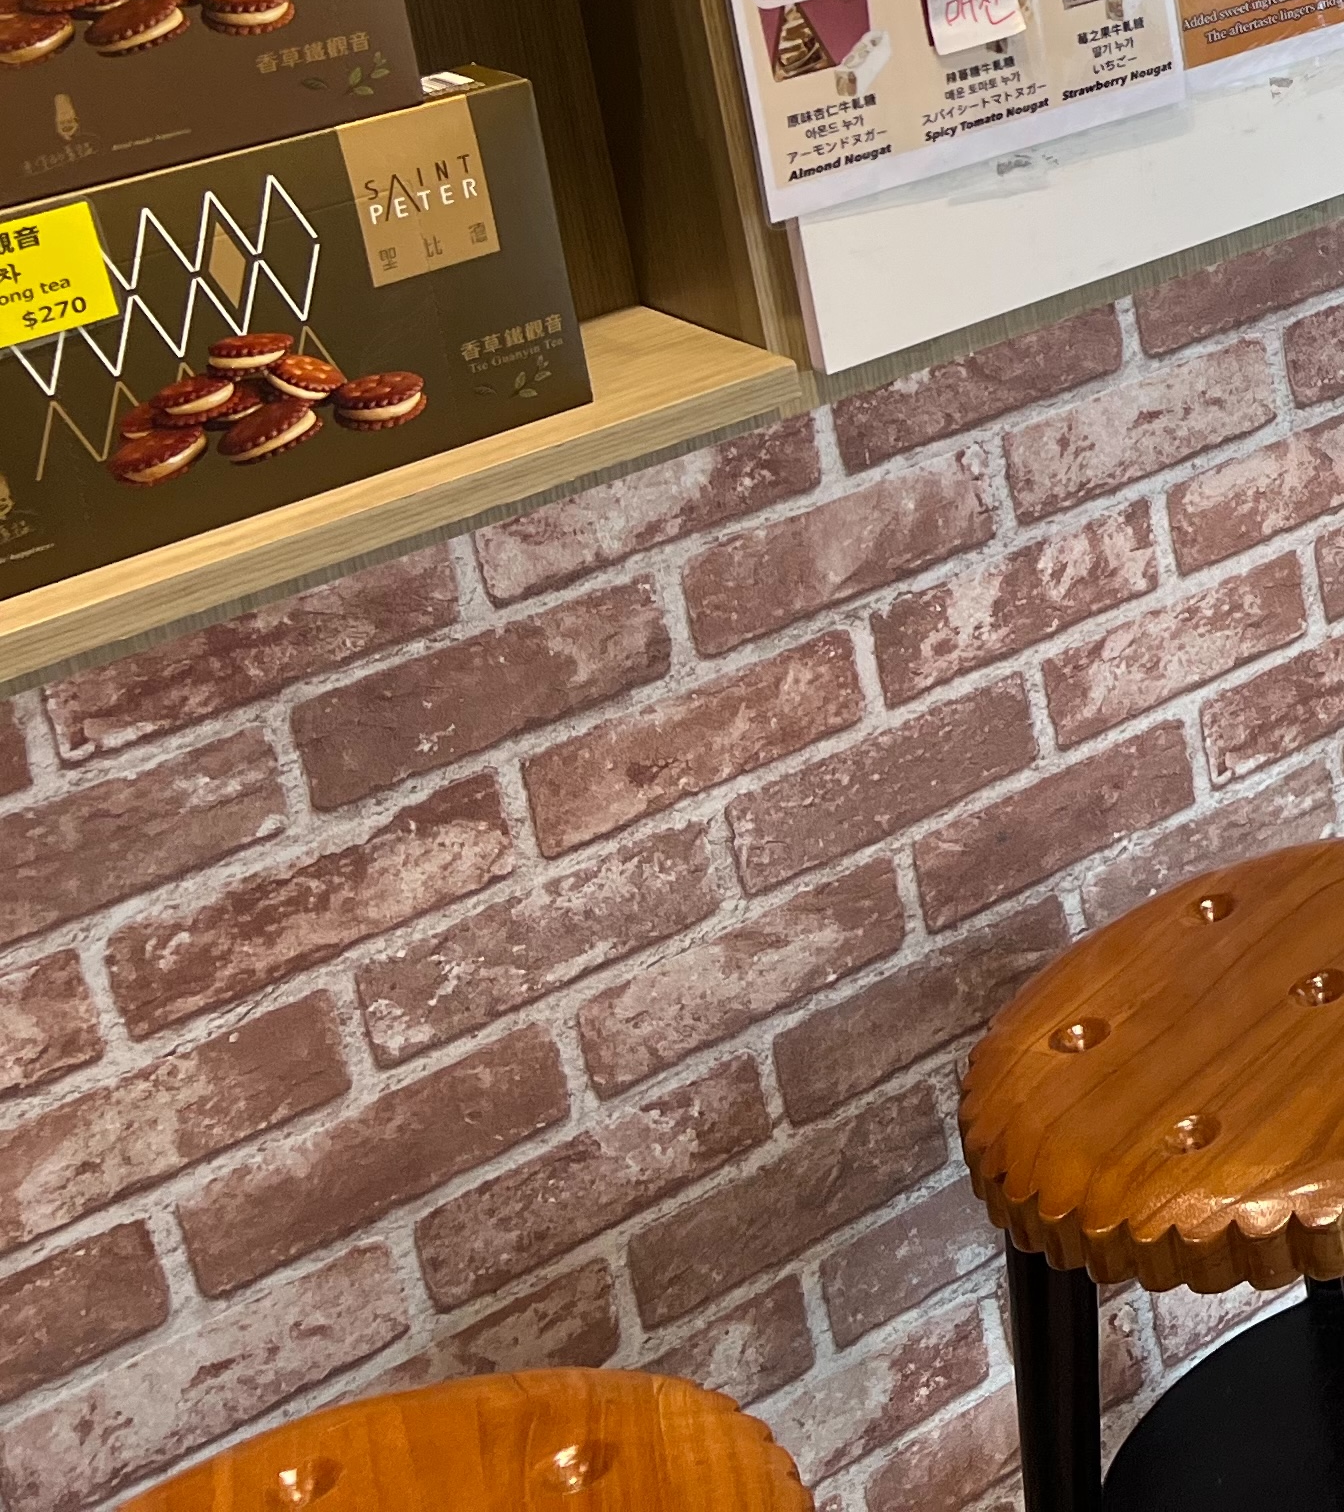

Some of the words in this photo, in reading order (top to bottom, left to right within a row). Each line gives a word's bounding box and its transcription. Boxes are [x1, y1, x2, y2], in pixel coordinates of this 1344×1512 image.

[1182, 10, 1218, 33] Added
[1219, 3, 1250, 21] sweet
[1205, 29, 1227, 44] The
[1228, 14, 1279, 37] aftertaste
[1280, 3, 1316, 24] lingers
[1062, 75, 1128, 101] Strawberry
[1130, 61, 1172, 82] Nougat
[924, 121, 957, 143] Spicy
[961, 109, 1004, 131] Tomato
[1006, 98, 1049, 119] Nougat
[788, 157, 841, 182] Almond
[844, 144, 892, 166] Nougat
[369, 178, 478, 225] PETER
[40, 277, 71, 294] tea
[22, 295, 87, 330] $270
